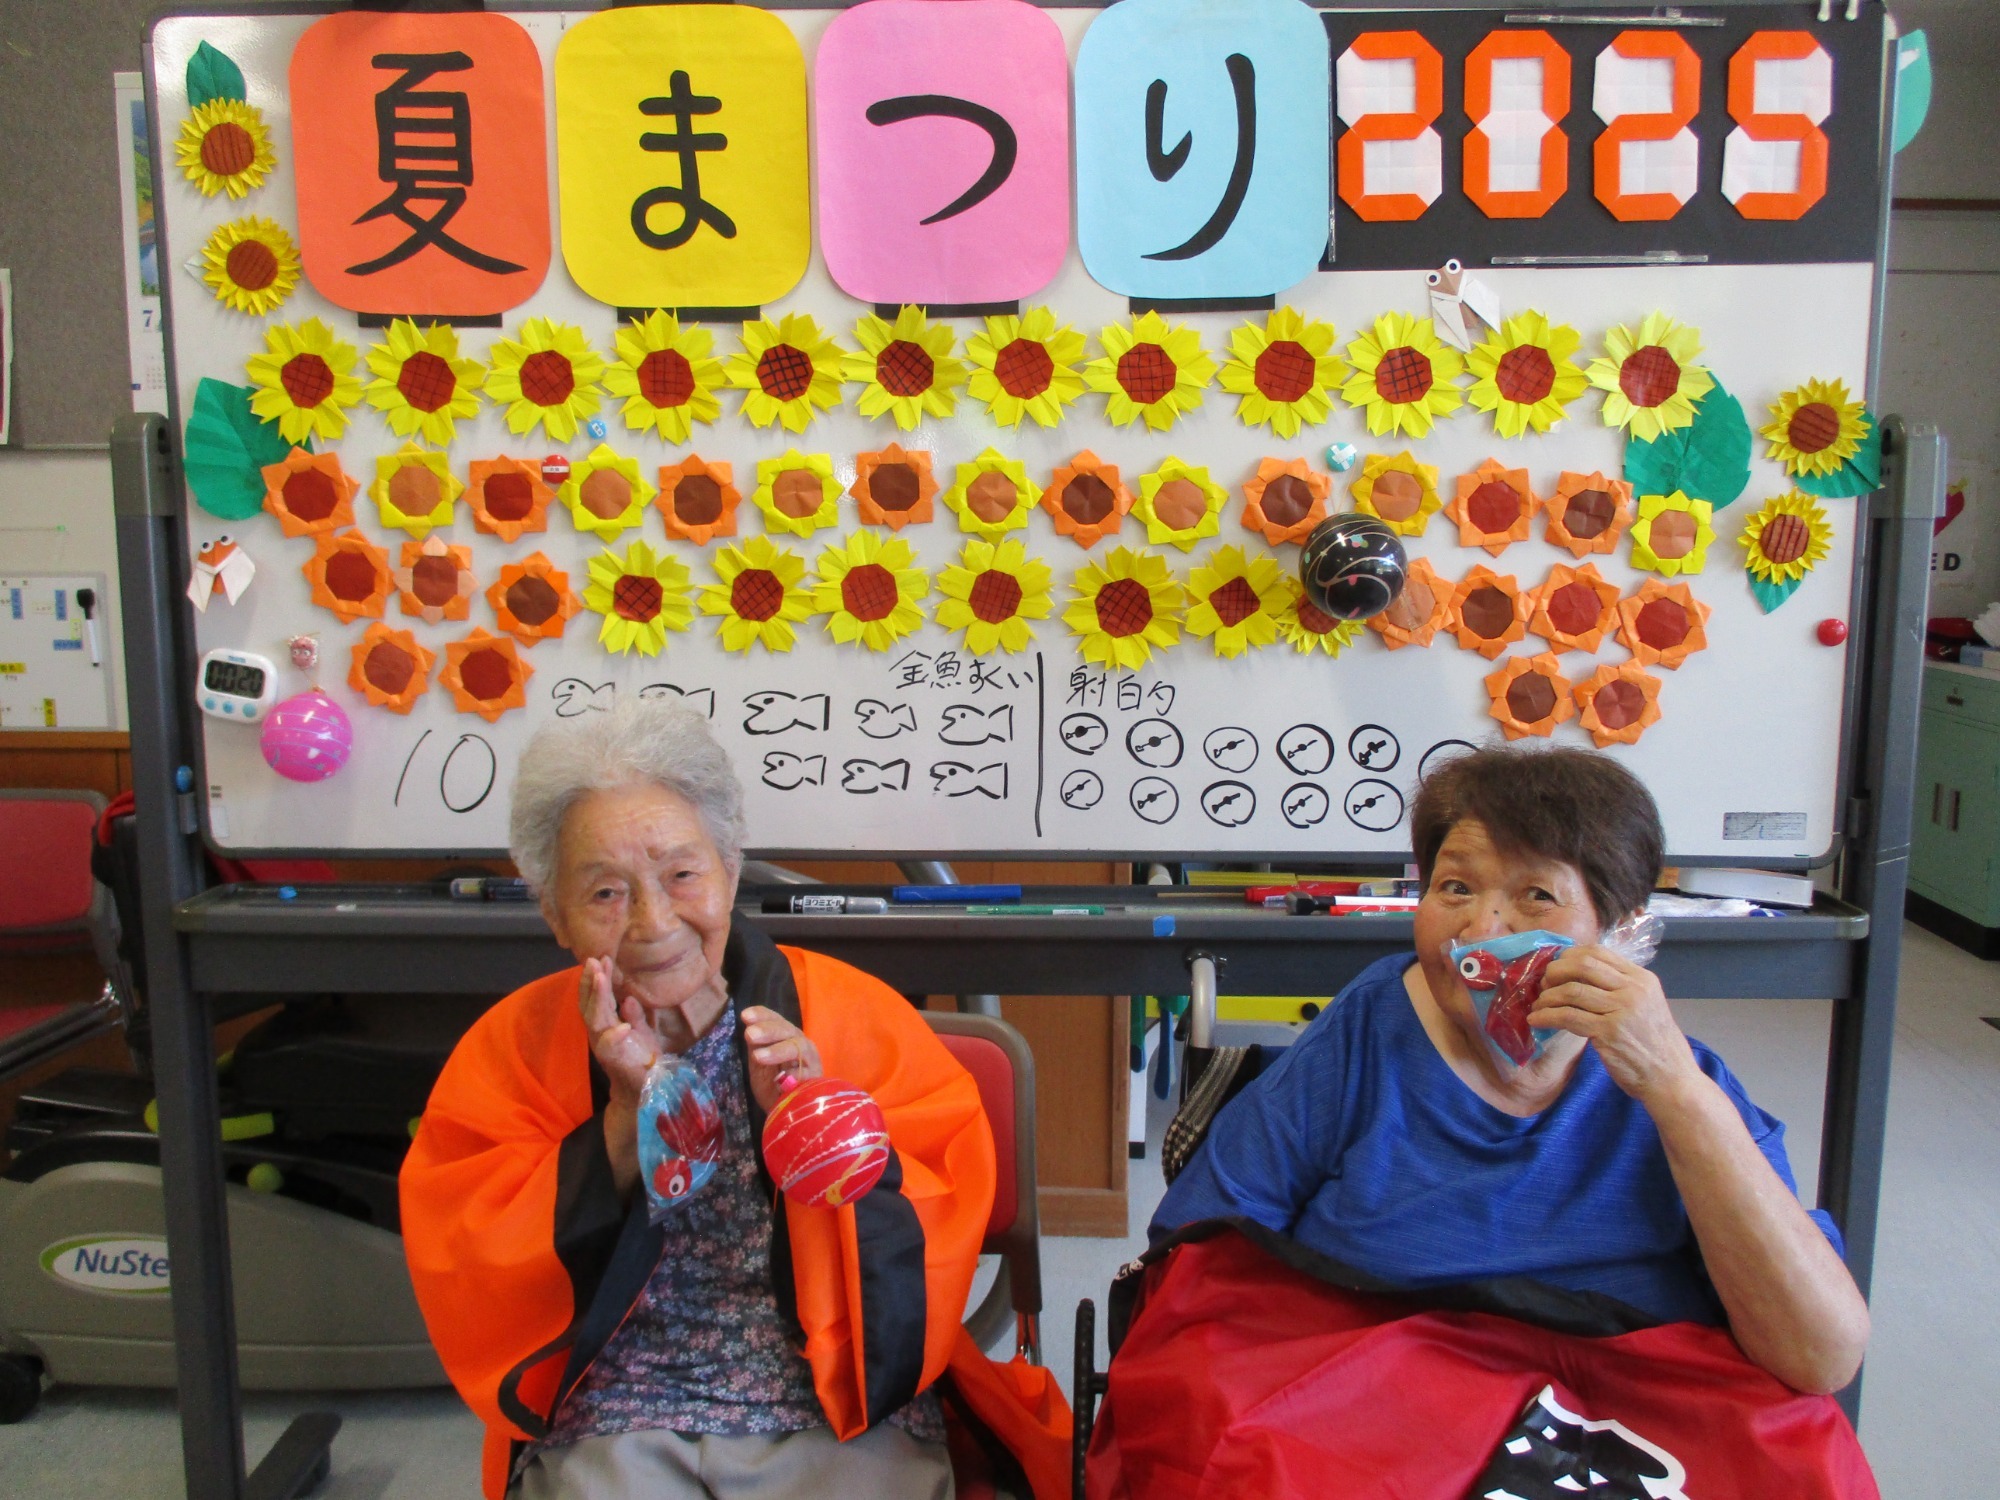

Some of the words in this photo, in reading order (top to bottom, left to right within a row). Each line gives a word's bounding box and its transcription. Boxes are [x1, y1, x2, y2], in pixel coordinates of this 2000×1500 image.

[1337, 30, 1832, 222] 2025
[345, 51, 1256, 275] 夏まつり
[142, 309, 153, 328] 7
[889, 650, 1034, 694] 金魚すくい
[1066, 664, 1176, 716] 射的
[395, 729, 496, 813] 10
[74, 1248, 170, 1278] NuSte
